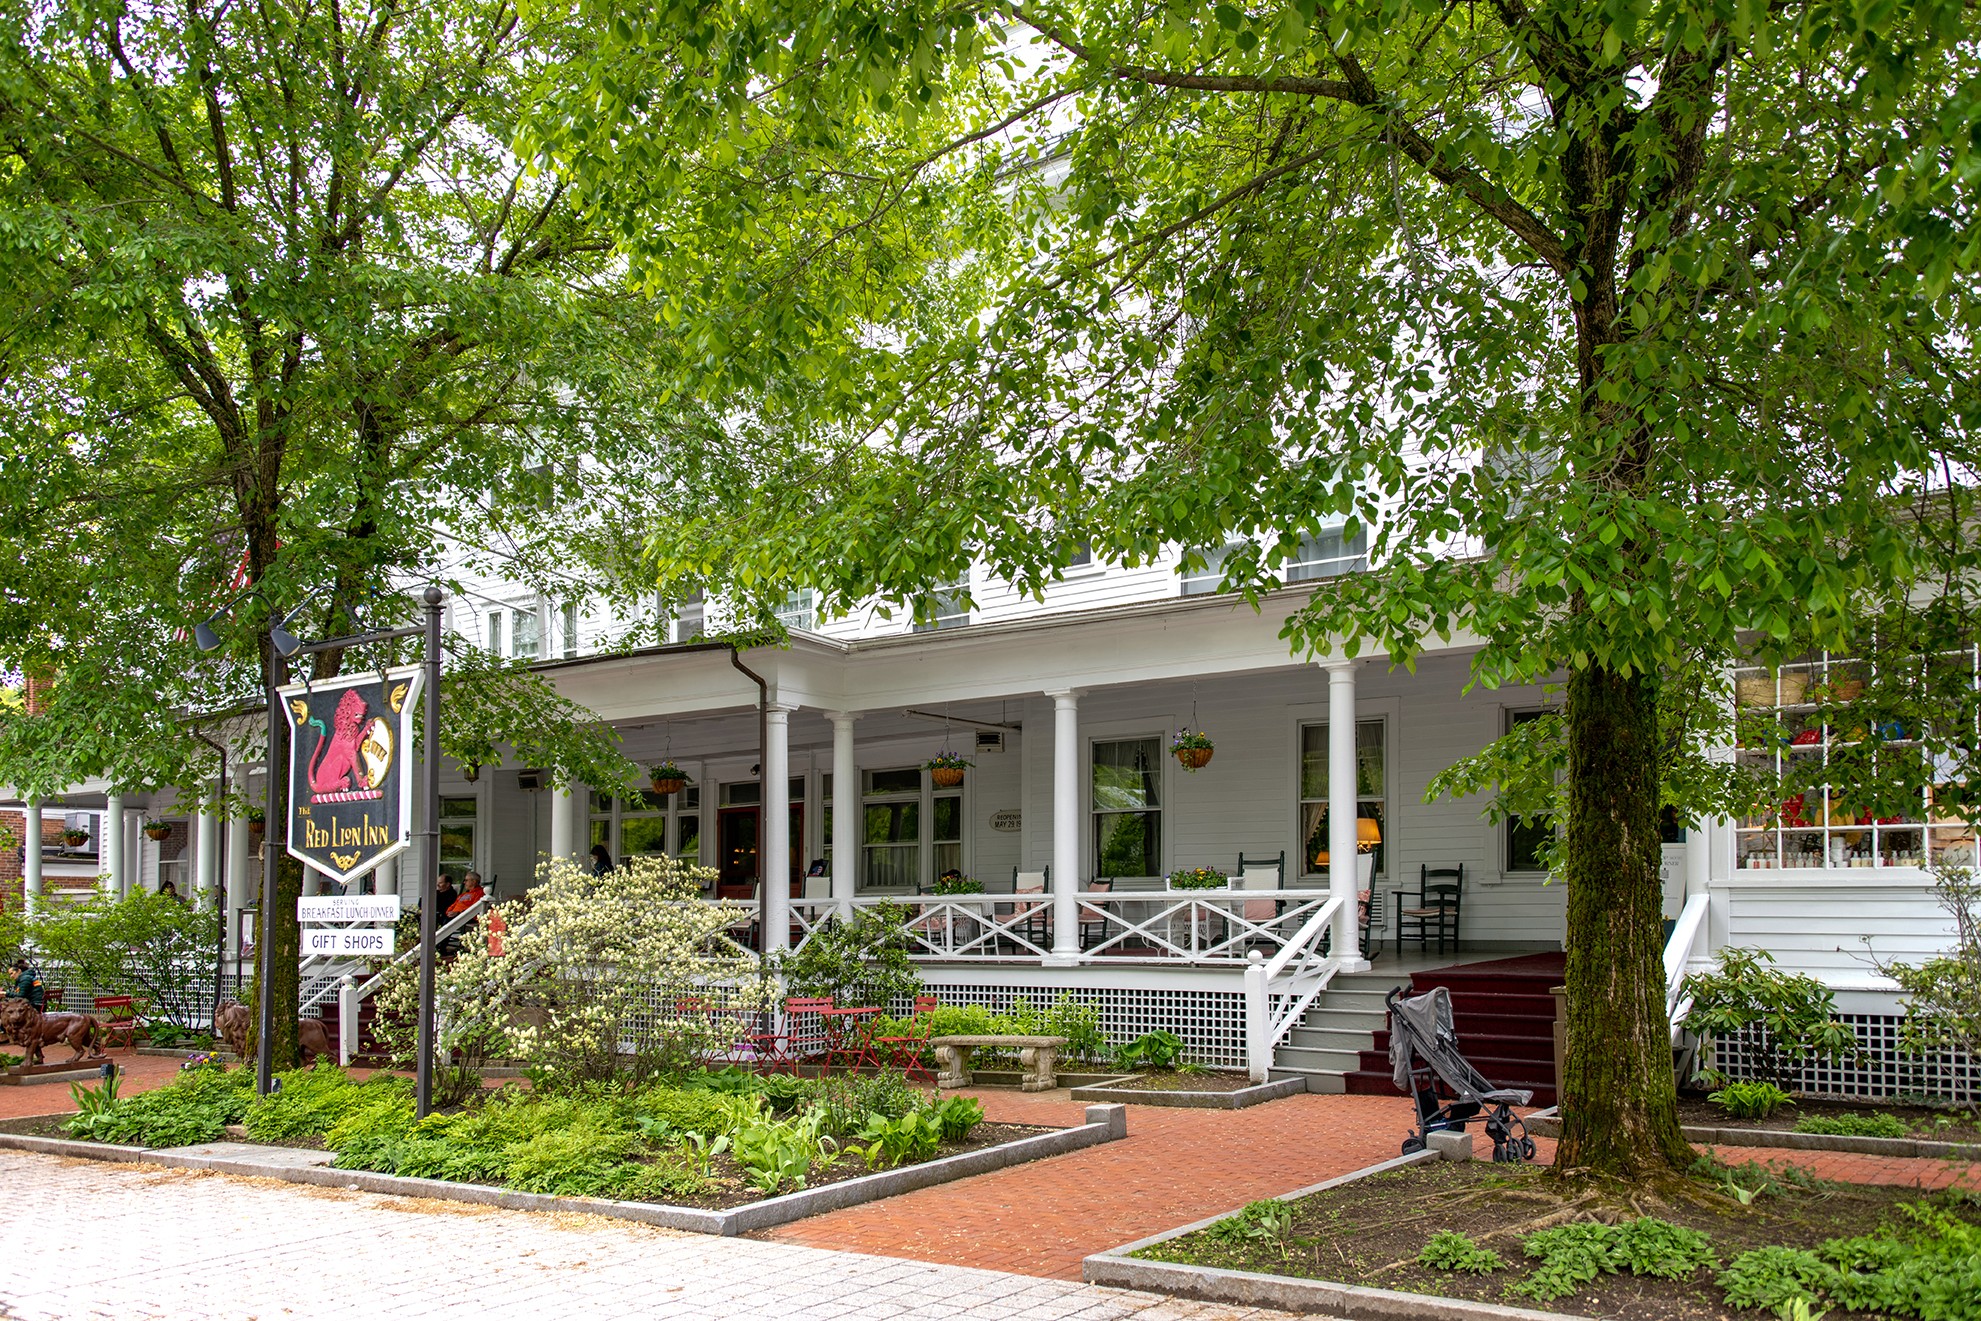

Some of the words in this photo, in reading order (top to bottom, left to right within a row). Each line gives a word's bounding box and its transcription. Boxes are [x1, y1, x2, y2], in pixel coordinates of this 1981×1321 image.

[305, 818, 329, 848] RED
[331, 815, 361, 847] LION
[363, 813, 389, 846] INN
[312, 935, 337, 948] GIFT
[344, 935, 384, 949] SHOPS
